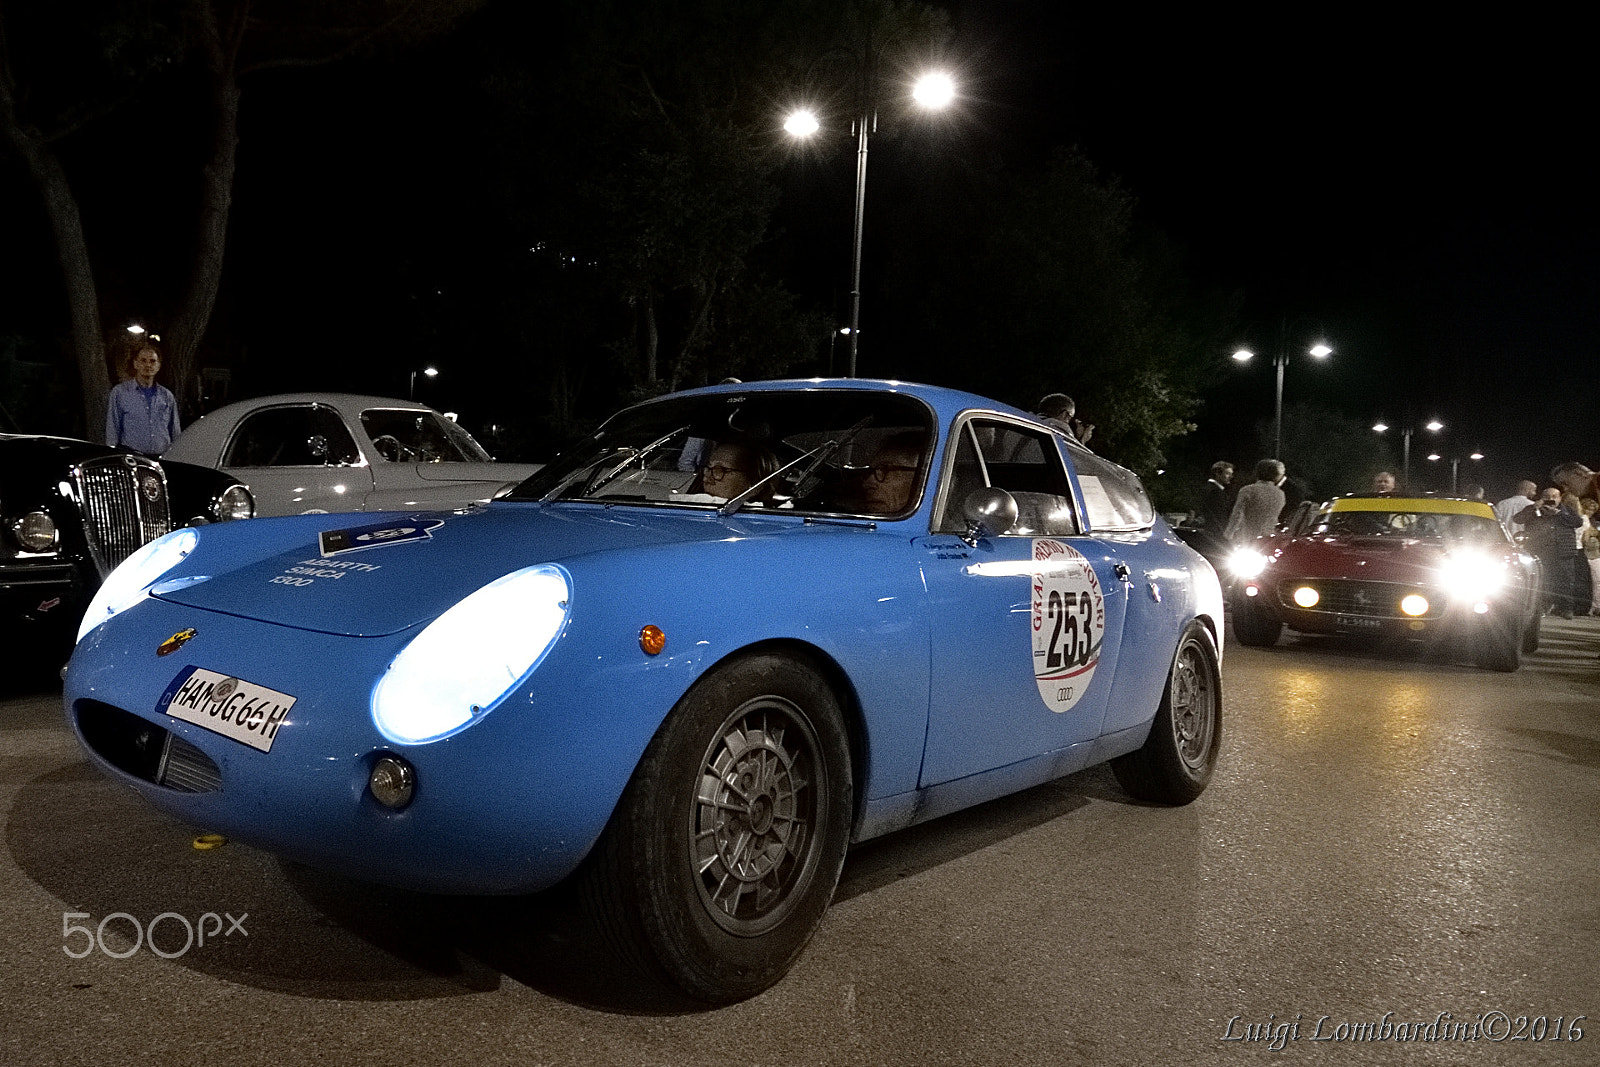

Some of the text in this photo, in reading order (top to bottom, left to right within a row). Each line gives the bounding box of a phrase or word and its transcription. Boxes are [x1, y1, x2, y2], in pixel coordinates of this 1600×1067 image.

[297, 558, 382, 573] ABARTH
[284, 566, 347, 580] SIMCA
[268, 575, 314, 587] 1300
[1046, 590, 1093, 668] 253
